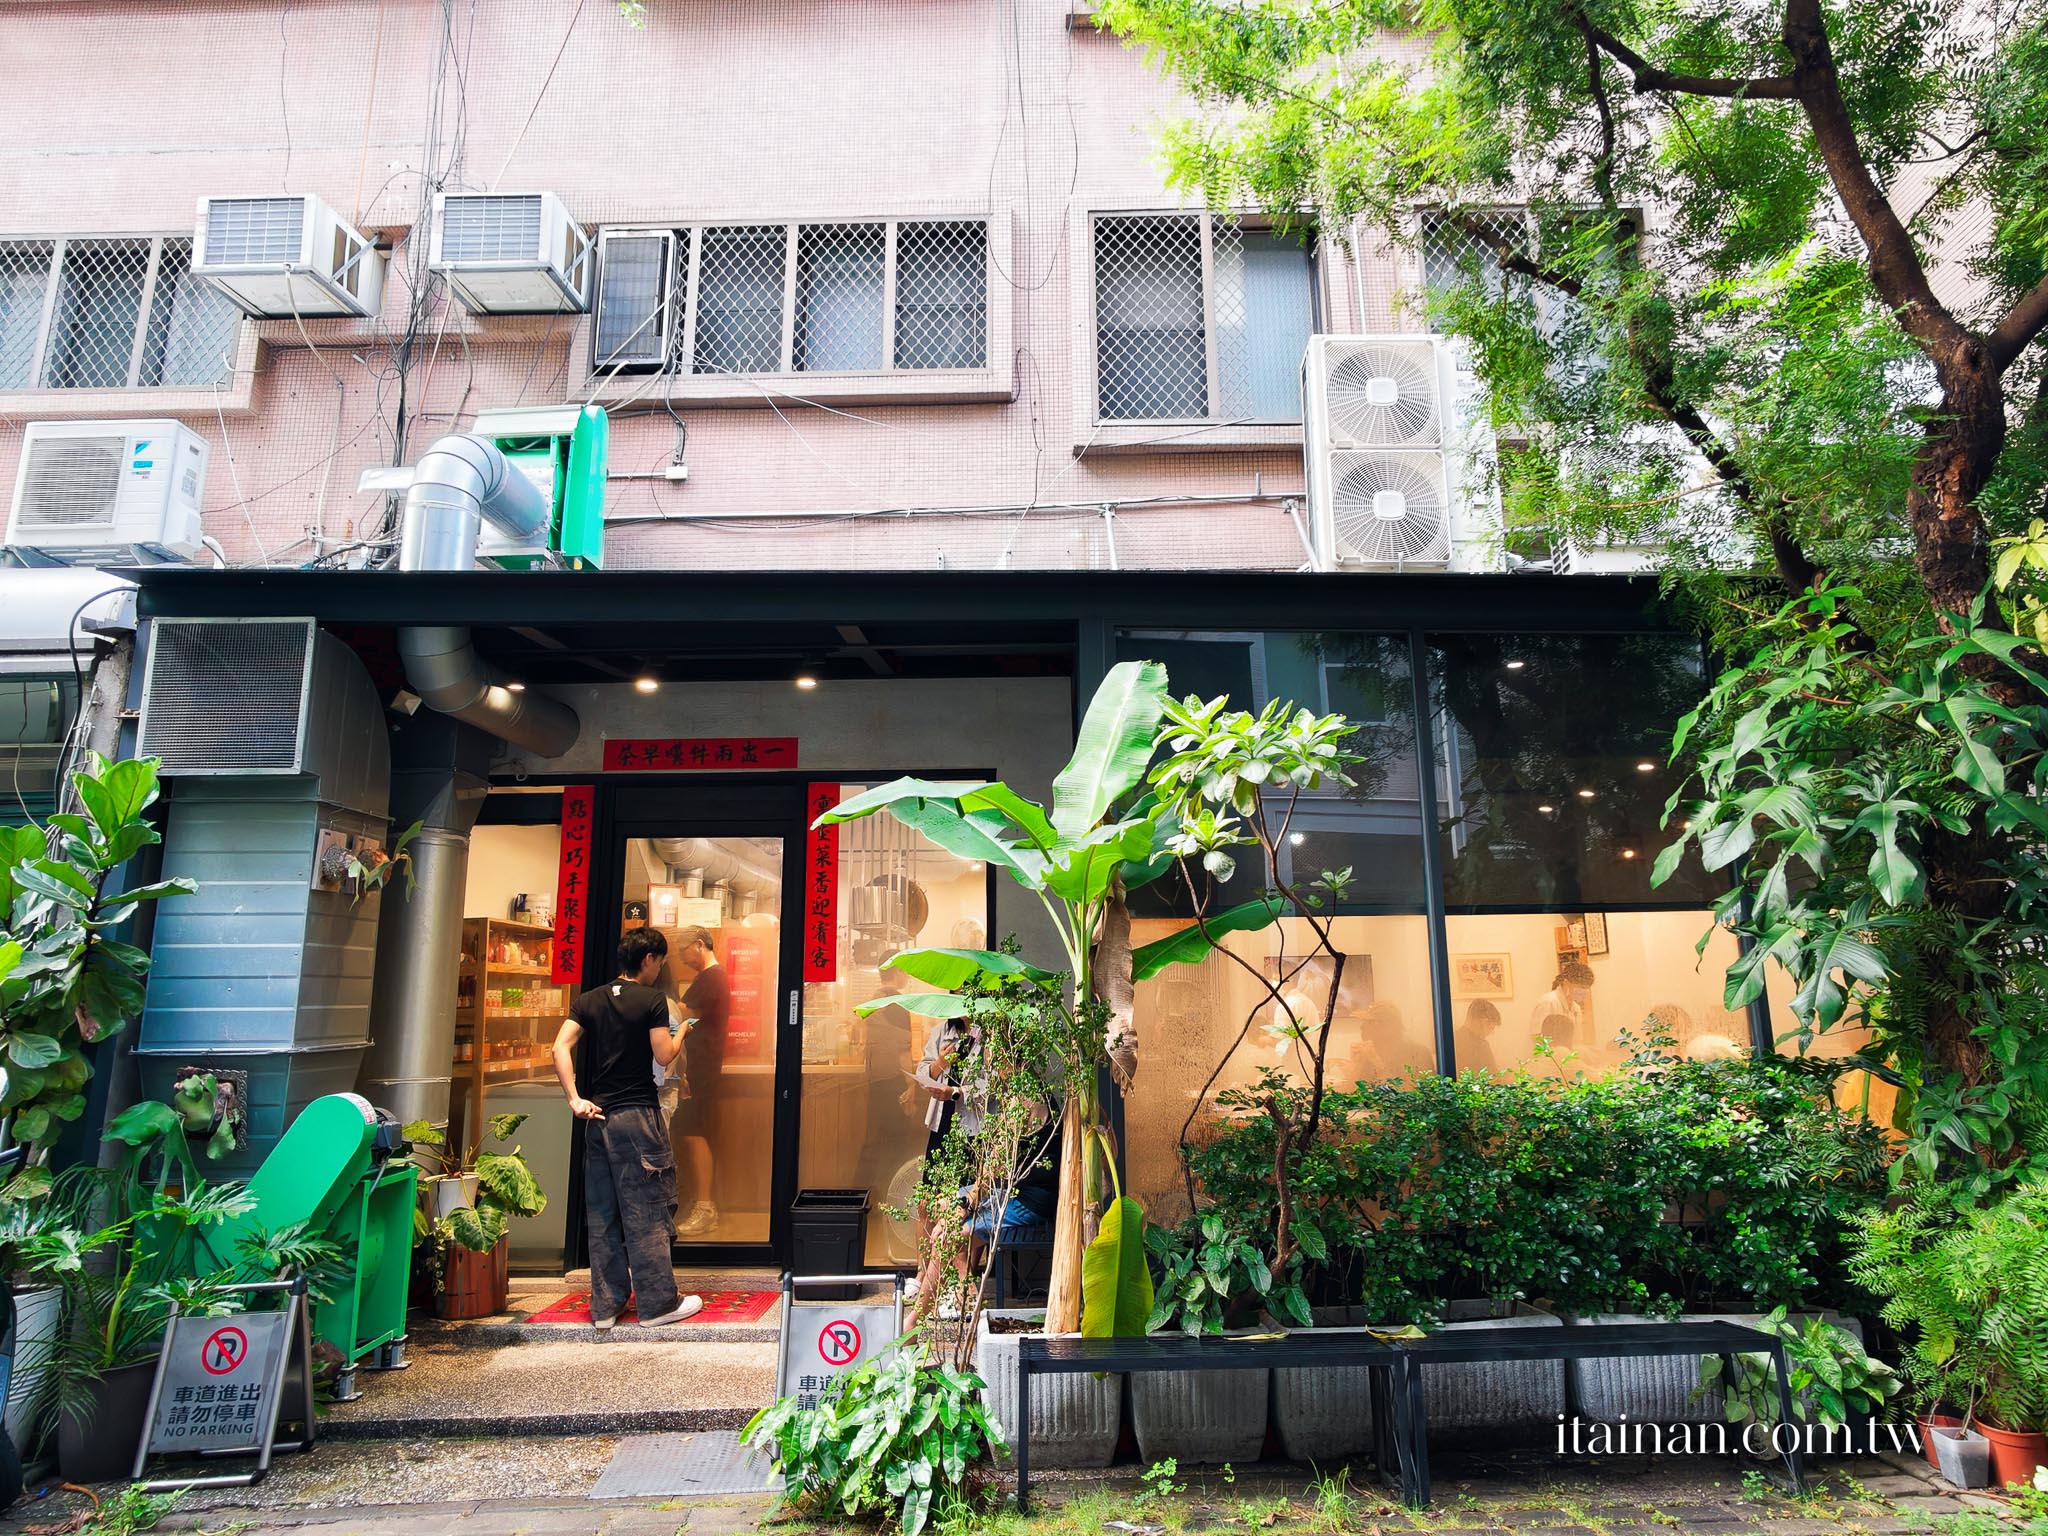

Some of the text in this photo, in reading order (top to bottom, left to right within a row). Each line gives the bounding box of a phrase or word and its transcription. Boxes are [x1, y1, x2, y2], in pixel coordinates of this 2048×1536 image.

[173, 1383, 261, 1404] 車道進出
[167, 1403, 257, 1425] 請勿停車
[164, 1423, 254, 1437] NO PARKING
